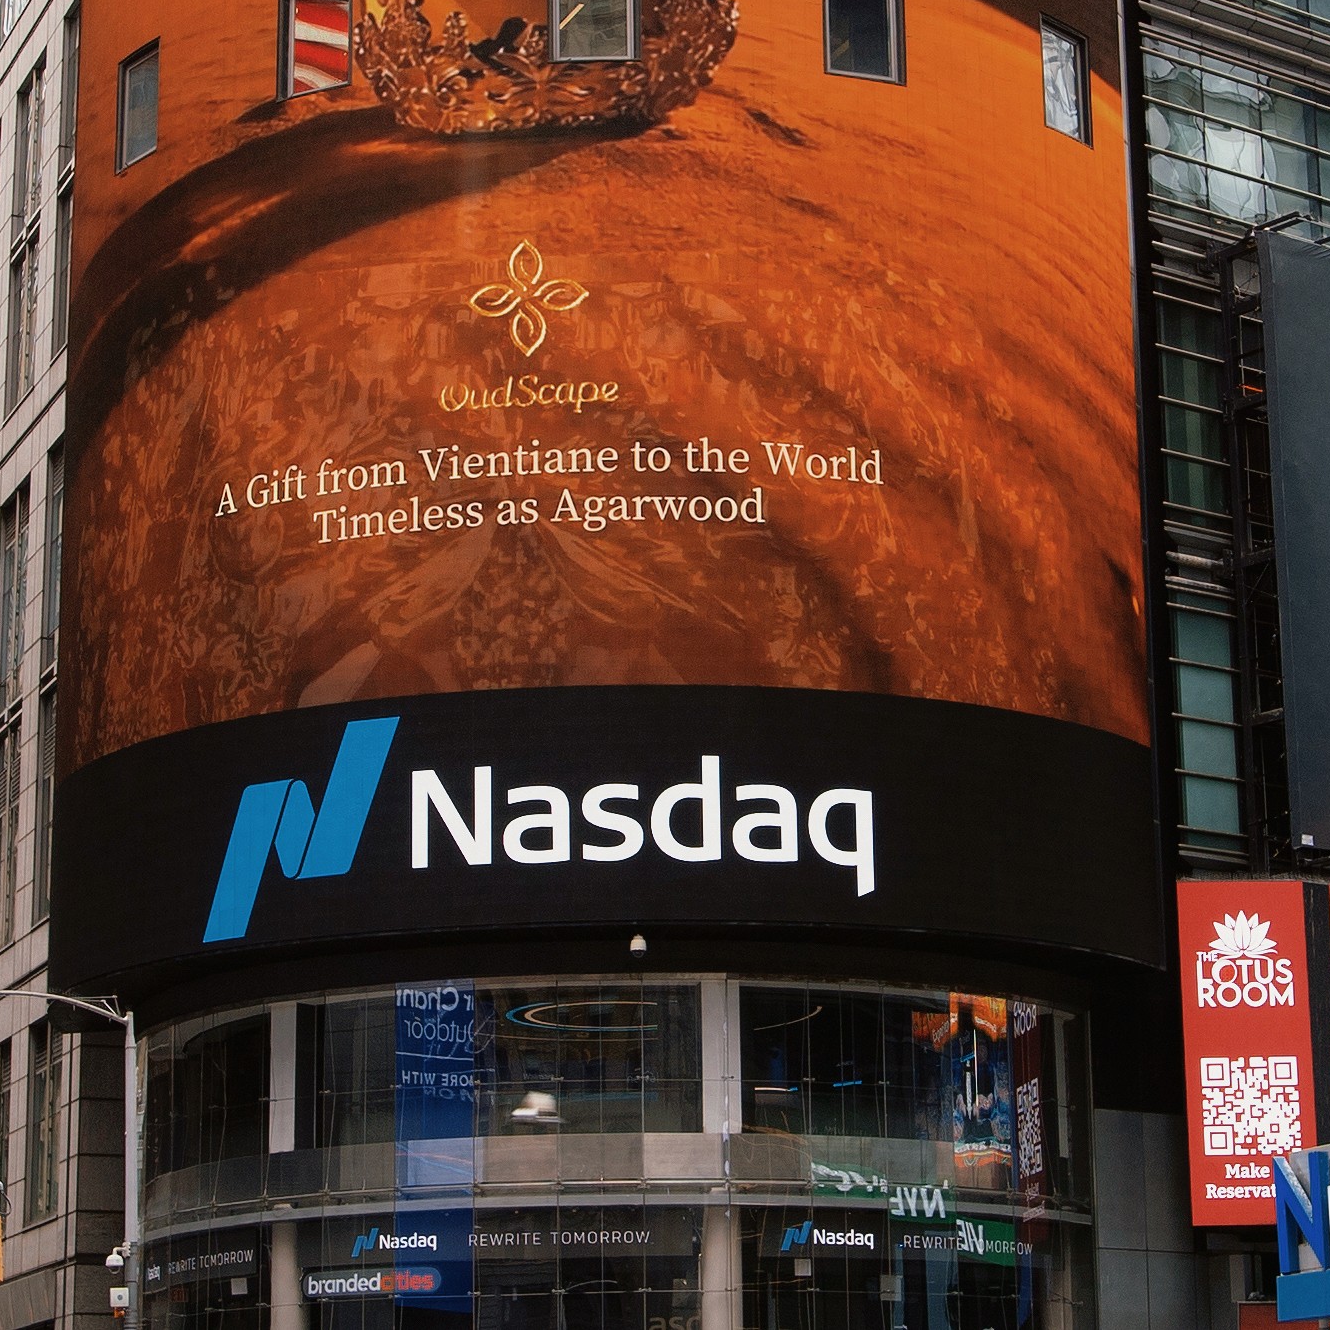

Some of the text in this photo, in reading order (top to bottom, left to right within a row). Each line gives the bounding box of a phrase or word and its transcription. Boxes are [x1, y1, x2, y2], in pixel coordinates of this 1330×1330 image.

[214, 437, 885, 517] A Gift from Vientiane to the World
[312, 487, 766, 545] Timeless as Agarwood
[412, 755, 874, 896] Nasdaq
[1196, 951, 1219, 963] THE
[1196, 958, 1294, 985] LOTUS
[1197, 981, 1295, 1008] ROOM
[1224, 1162, 1271, 1180] Make
[379, 1231, 437, 1251] Nasdaq
[468, 1230, 651, 1247] REWRITE TOMORROW
[813, 1228, 875, 1250] Nasdaq
[307, 1269, 435, 1296] brandedcities
